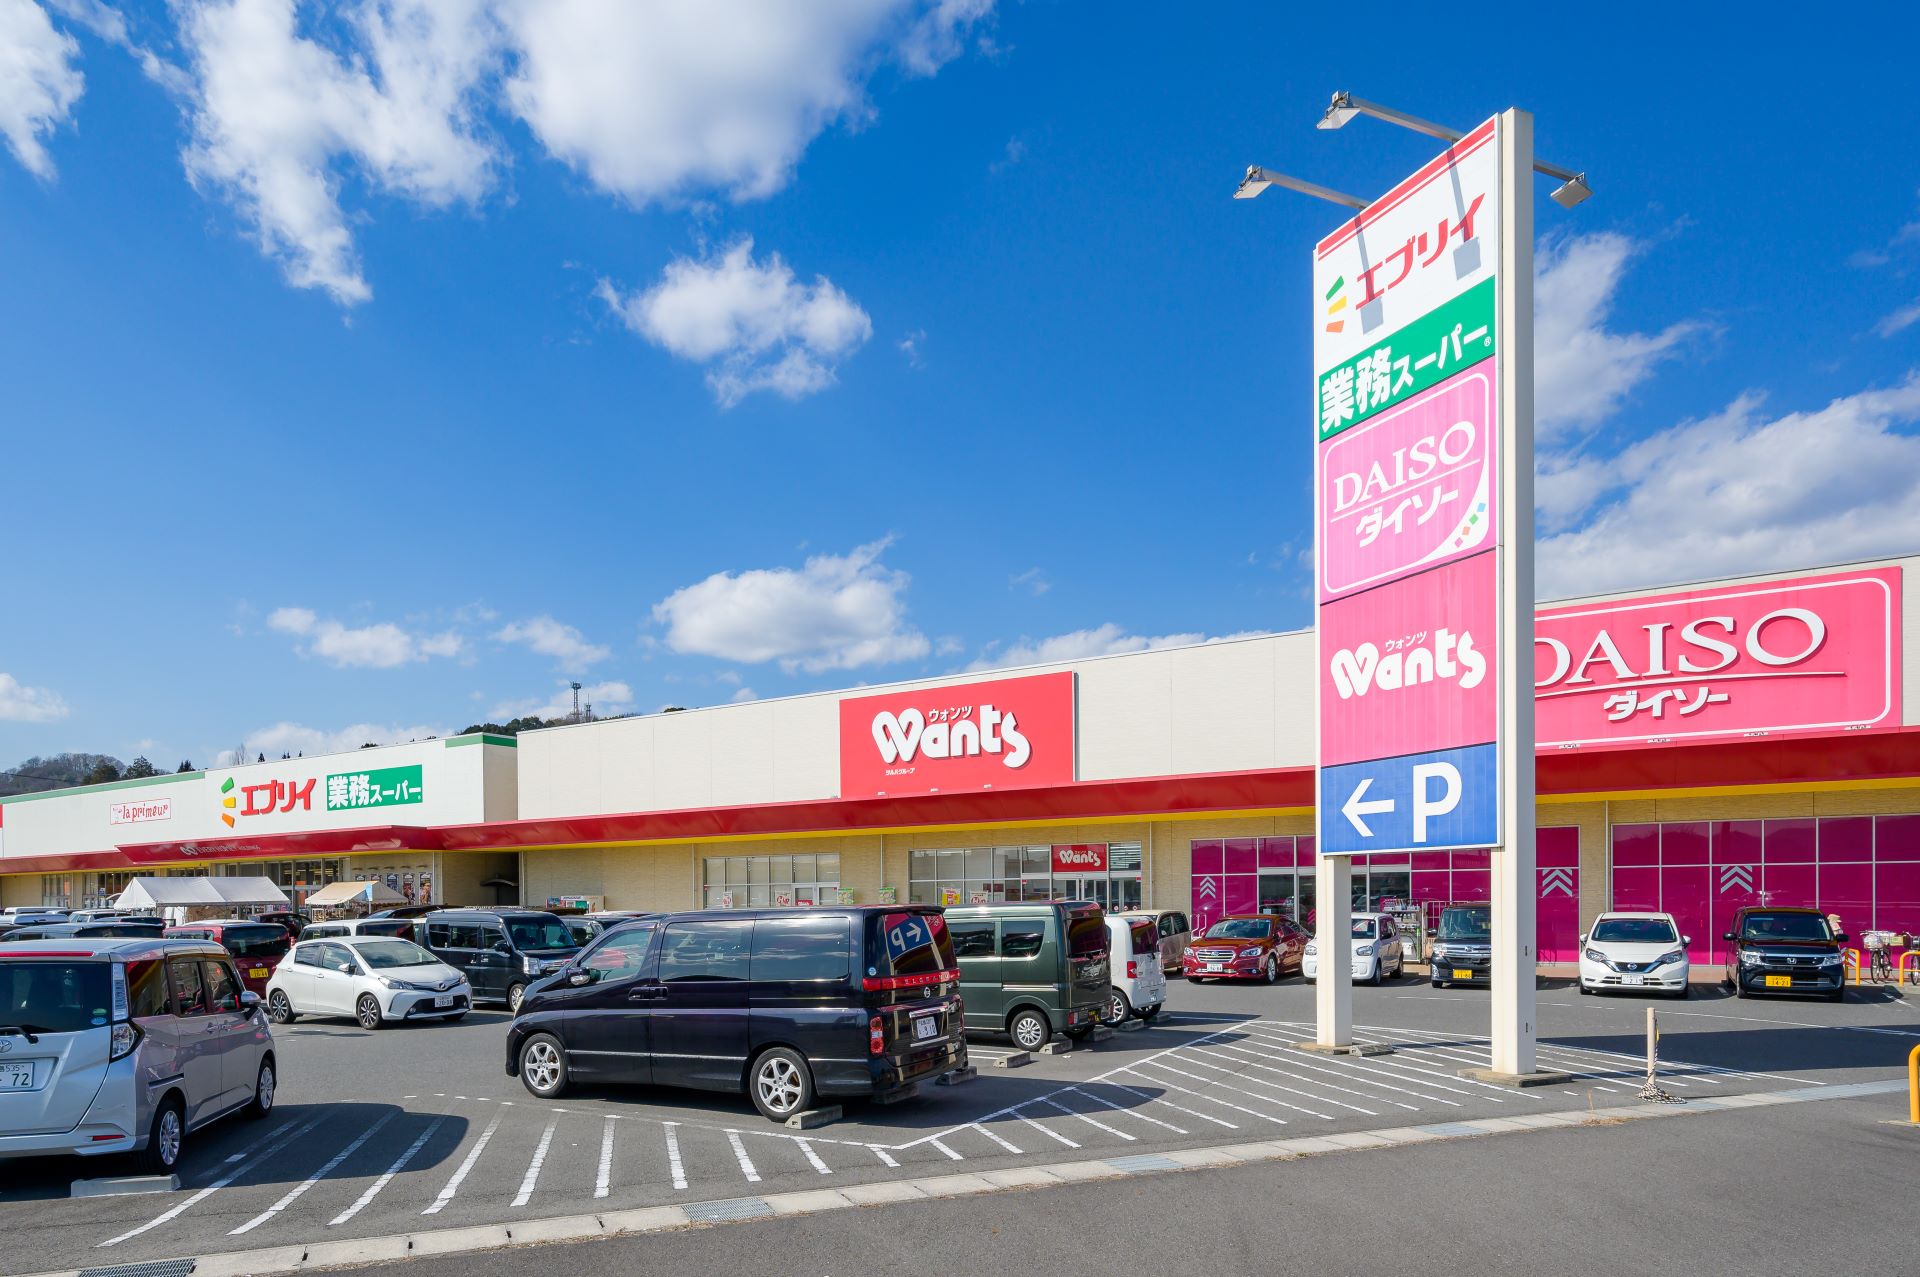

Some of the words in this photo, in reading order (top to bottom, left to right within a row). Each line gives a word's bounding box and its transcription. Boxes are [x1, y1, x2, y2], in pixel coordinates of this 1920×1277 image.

[1355, 192, 1485, 310] エブリイ
[1321, 323, 1488, 433] 業務スーパー
[1334, 421, 1476, 513] DAISO
[1356, 485, 1459, 548] ダイソー
[1330, 628, 1487, 700] Wants
[1385, 631, 1427, 652] ウォンツ
[928, 705, 973, 723] ウォンツ
[1603, 687, 1729, 721] ダイソー
[871, 704, 1032, 769] Wants
[122, 804, 131, 819] la
[131, 803, 169, 822] primeur
[240, 778, 317, 816] エブリイ
[328, 774, 422, 808] 業務スーパー
[1412, 761, 1463, 843] P
[1059, 849, 1101, 867] Wants
